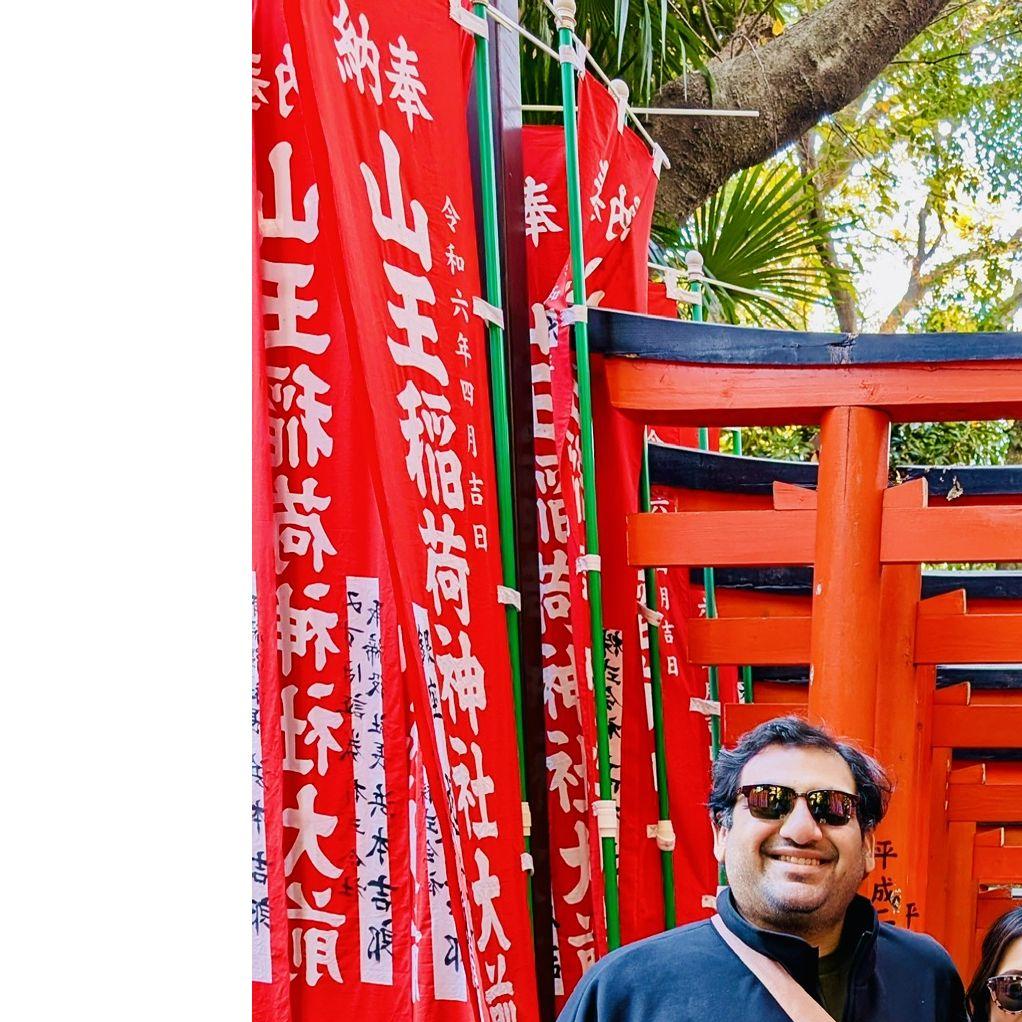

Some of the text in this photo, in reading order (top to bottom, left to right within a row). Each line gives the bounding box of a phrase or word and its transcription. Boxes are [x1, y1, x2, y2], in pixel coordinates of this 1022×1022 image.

[441, 195, 489, 553] 令和六年四月吉日
